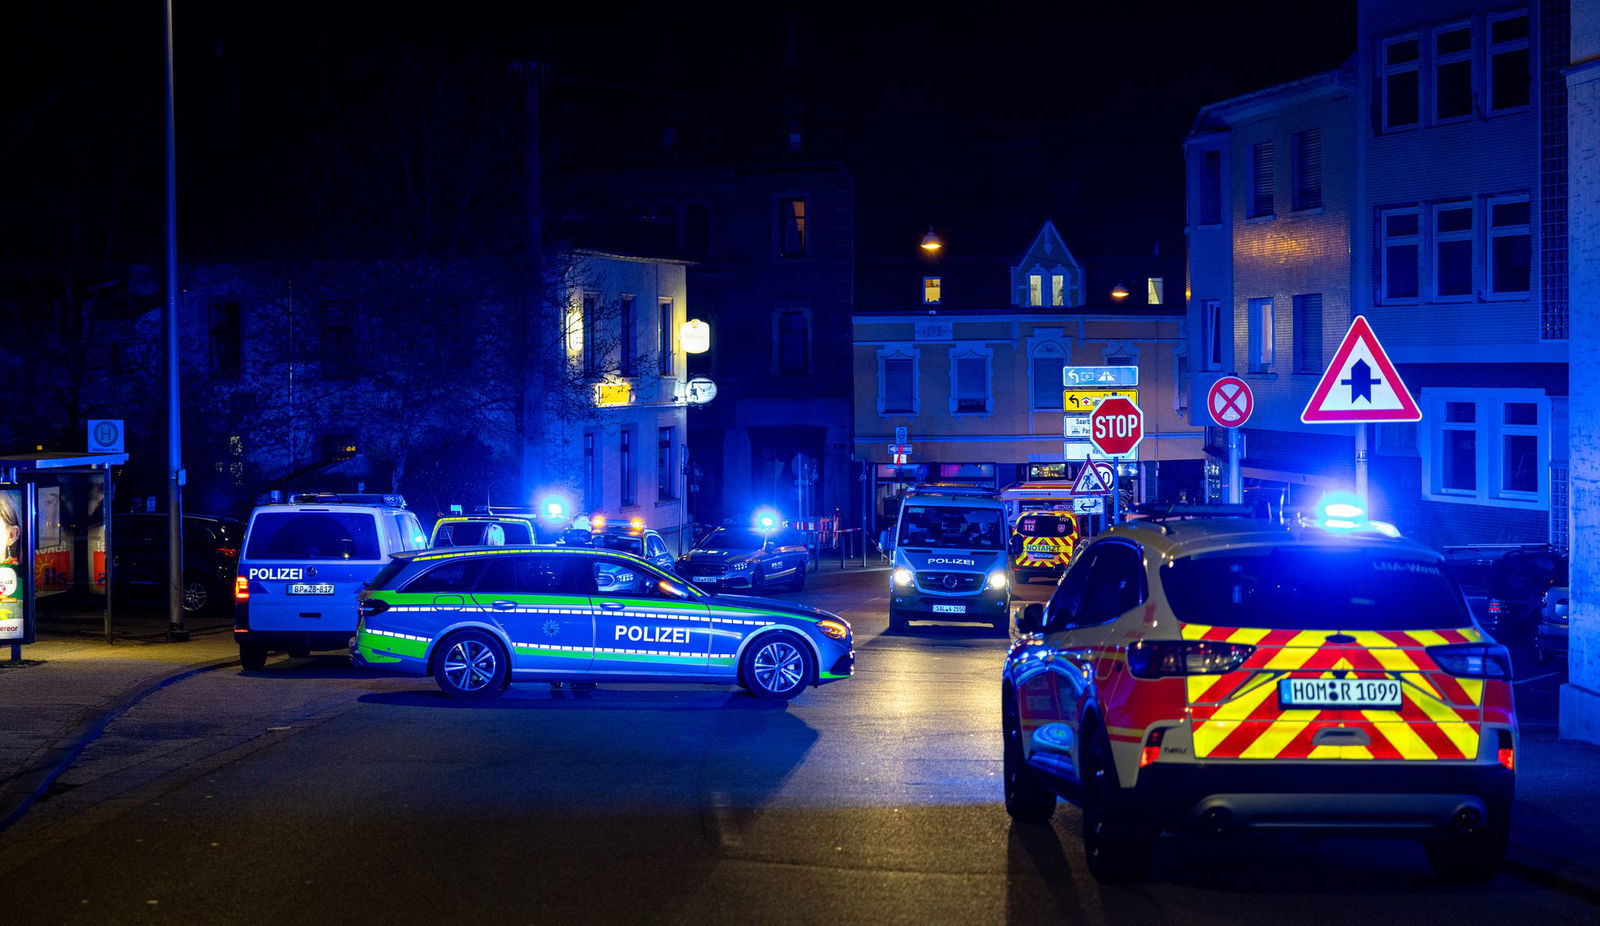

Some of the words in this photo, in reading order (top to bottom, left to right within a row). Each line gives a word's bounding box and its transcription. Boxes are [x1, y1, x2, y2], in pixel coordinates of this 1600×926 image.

[1095, 415, 1138, 438] STOP
[927, 558, 975, 566] POLIZEI
[249, 568, 303, 580] POLIZEI
[294, 585, 304, 593] BP
[615, 625, 690, 643] POLIZEI
[1293, 683, 1327, 700] HOM
[1341, 683, 1351, 700] R
[1356, 683, 1397, 701] 1099
